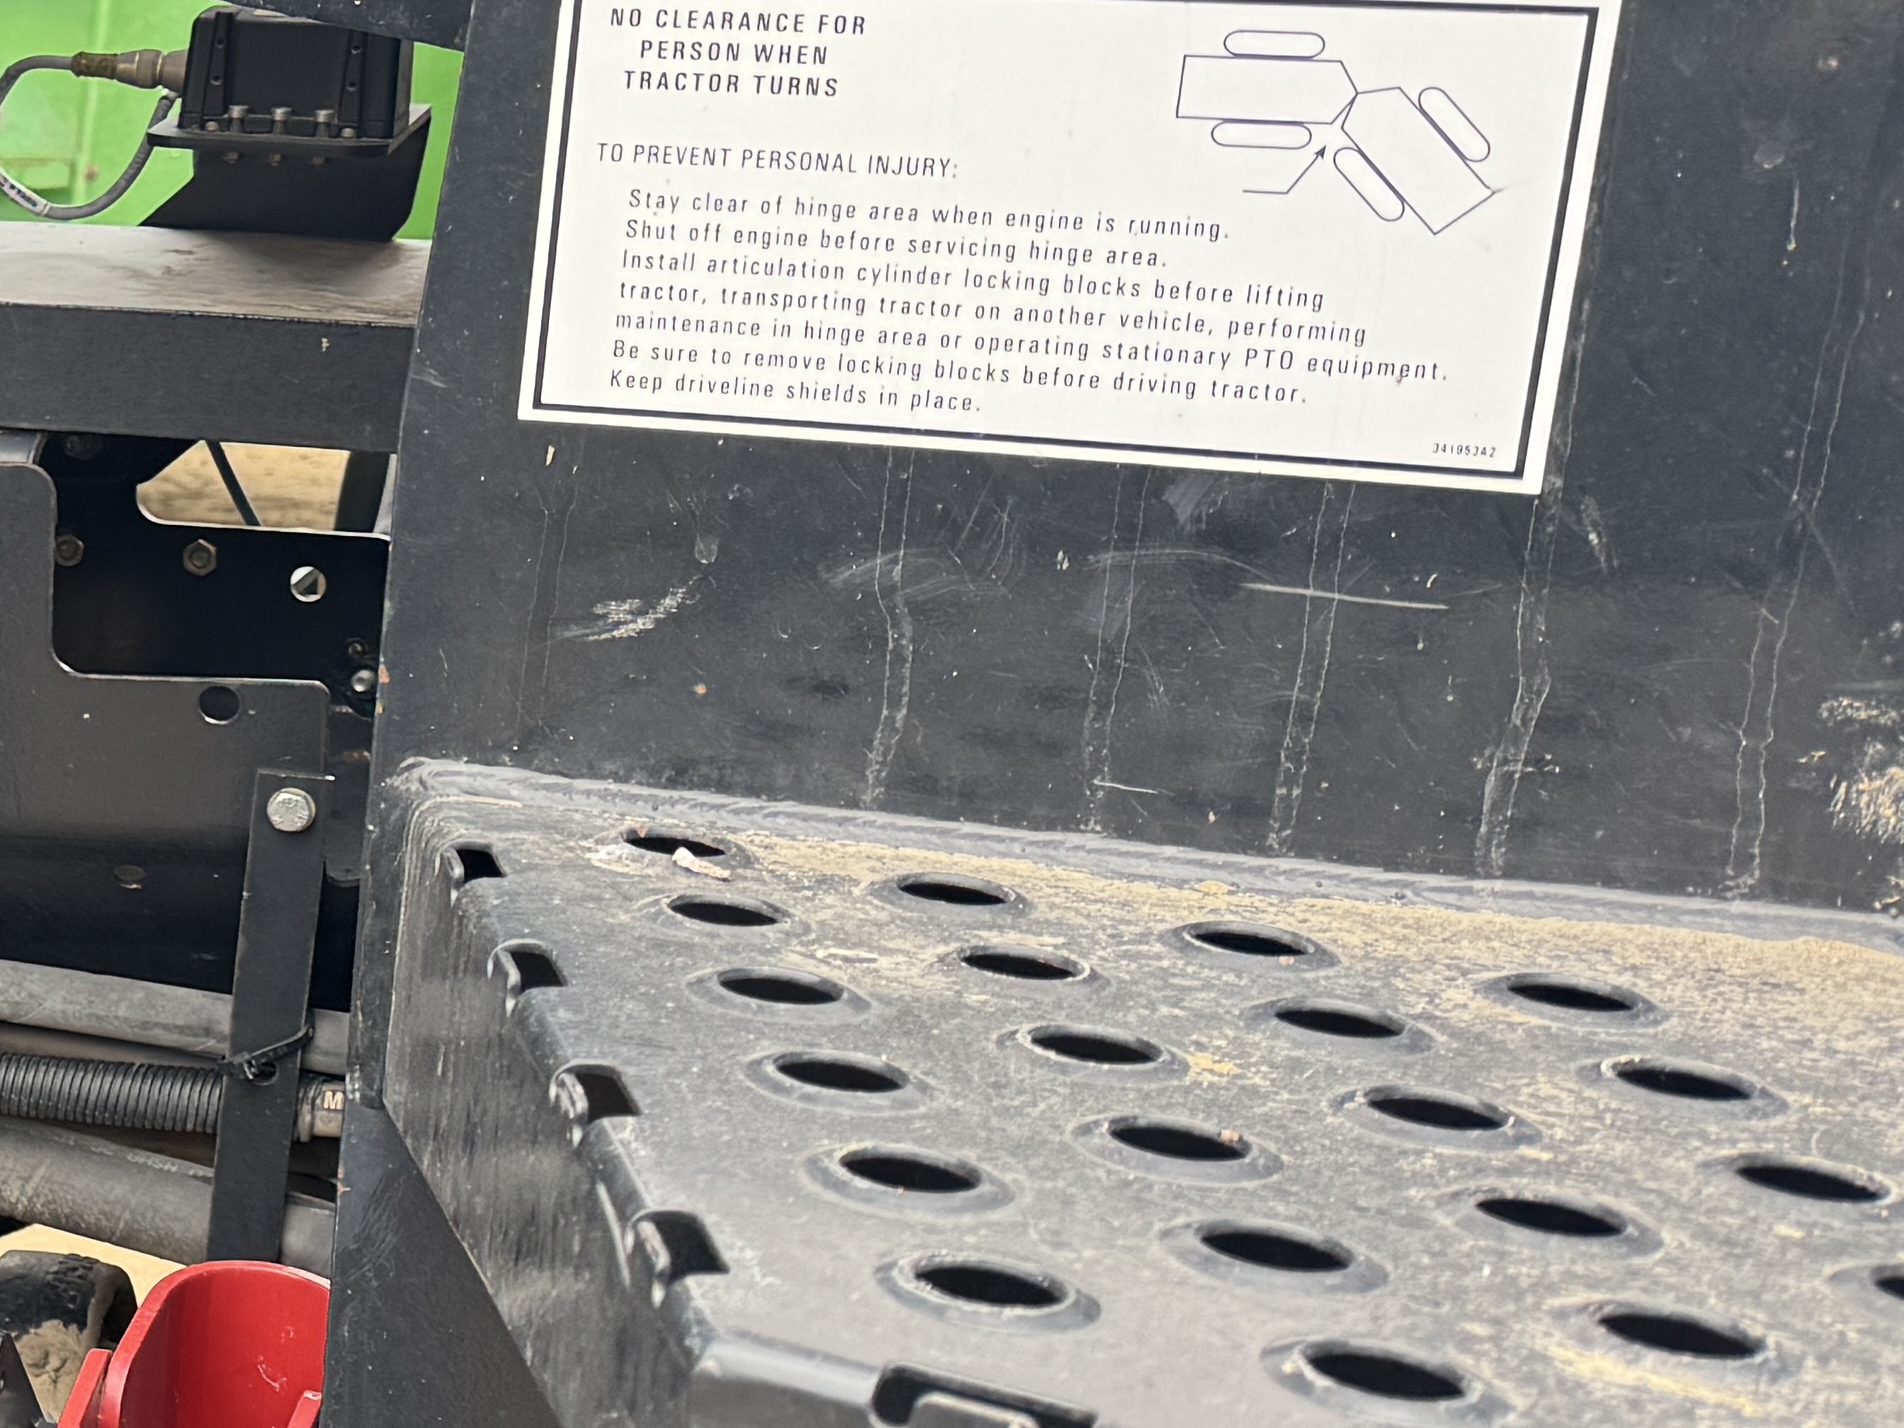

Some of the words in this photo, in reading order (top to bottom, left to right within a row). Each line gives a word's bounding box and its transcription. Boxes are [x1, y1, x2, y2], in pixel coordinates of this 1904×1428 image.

[610, 7, 642, 28] NO
[655, 8, 805, 34] CLEARANCE
[817, 13, 866, 36] FOR
[639, 39, 741, 62] PERSON
[753, 43, 828, 66] WHEN
[623, 69, 740, 94] TRACTOR
[752, 74, 838, 98] TURNS
[597, 142, 624, 163] TO
[632, 144, 732, 168] PREVENT
[741, 148, 857, 174] PERSONAL
[867, 154, 958, 179] INJURY:
[628, 188, 680, 217] Stay
[692, 191, 748, 213] clear
[760, 195, 783, 215] of
[794, 196, 856, 223] hinge
[868, 205, 919, 222] area
[931, 203, 993, 226] when
[1005, 209, 1084, 234] engine
[1096, 211, 1115, 233] is
[1128, 215, 1229, 243] running.
[625, 218, 676, 241] Shut
[689, 222, 722, 243] off
[733, 225, 808, 250] engine
[820, 228, 895, 253] before
[907, 236, 1016, 264] servicing
[1029, 239, 1093, 267] hinge
[1106, 249, 1166, 268] area.
[622, 248, 696, 272] Install
[706, 254, 845, 281] articulation
[856, 262, 953, 287] cylinder
[963, 267, 1050, 297] locking
[1063, 273, 1141, 298] blocks
[1154, 278, 1233, 303] before
[1246, 283, 1324, 313] lifting
[620, 281, 707, 306] tractor,
[721, 287, 866, 317] transporting
[879, 296, 963, 318] tractor
[974, 304, 1000, 321] on
[1013, 304, 1107, 327] another
[1119, 309, 1213, 337] vehicle,
[1227, 316, 1366, 348] performing
[612, 339, 639, 359] Be
[650, 346, 698, 363] sure
[711, 347, 732, 365] to
[743, 352, 826, 371] remove
[838, 352, 922, 382] locking
[934, 358, 1010, 383] blocks
[1022, 364, 1100, 389] before
[1113, 371, 1197, 401] driving
[1211, 379, 1306, 404] tractor.
[615, 310, 761, 337] maintenance
[772, 318, 791, 339] in
[804, 319, 865, 347] hinge
[877, 329, 927, 347] area
[940, 334, 963, 349] or
[974, 335, 1089, 362] operating
[1101, 340, 1231, 372] stationary
[1244, 347, 1294, 371] PTO
[1307, 354, 1447, 385] equipment.
[610, 368, 663, 395] Keep
[675, 373, 774, 398] driveline
[785, 380, 867, 405] shields
[879, 385, 898, 407] in
[910, 388, 980, 413] place.
